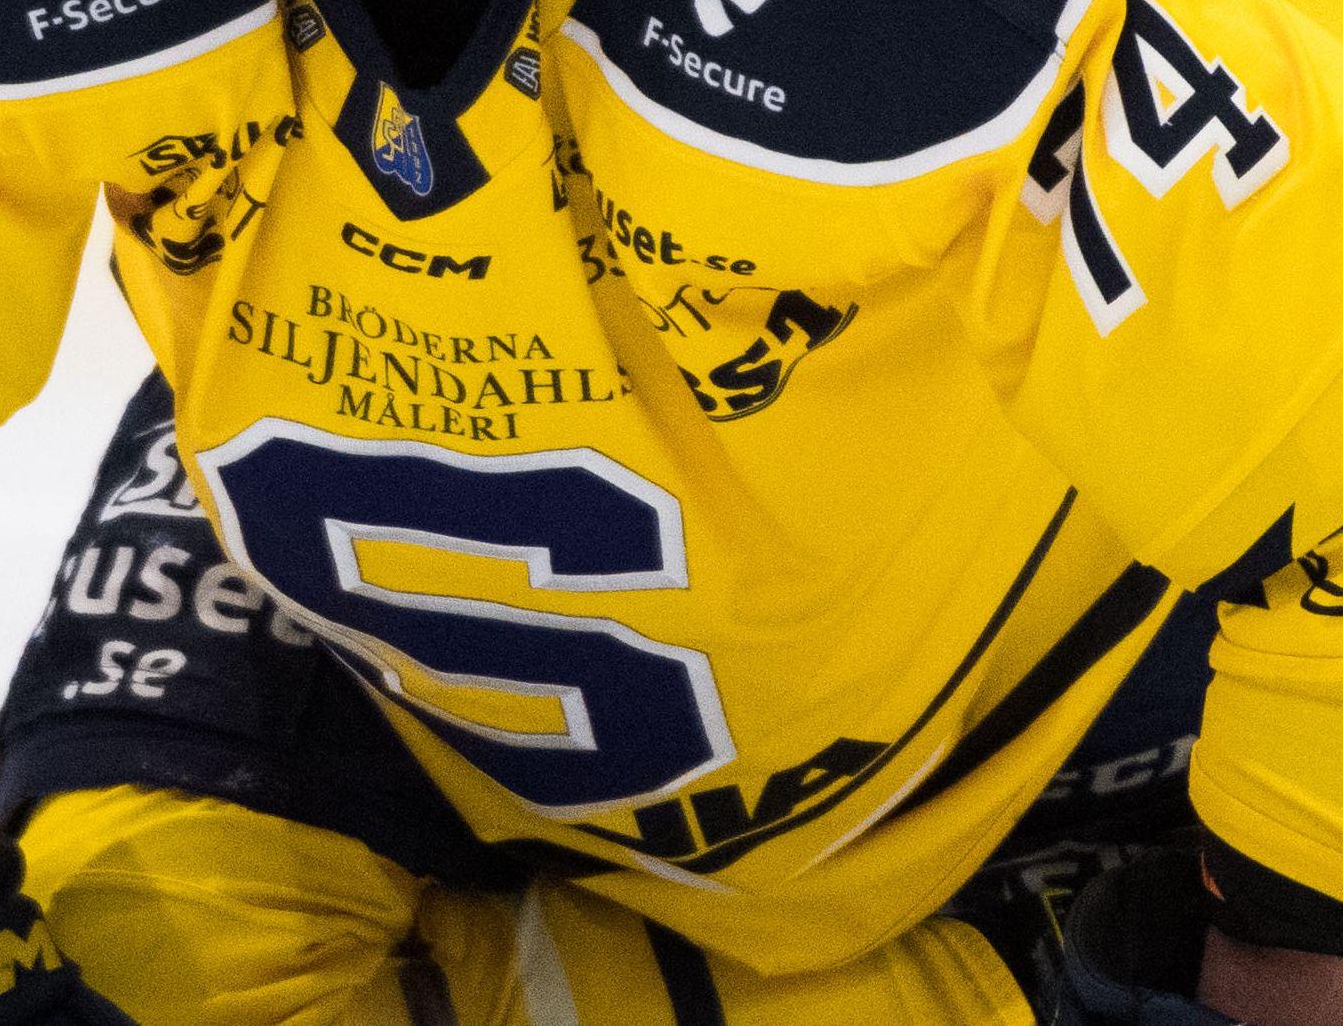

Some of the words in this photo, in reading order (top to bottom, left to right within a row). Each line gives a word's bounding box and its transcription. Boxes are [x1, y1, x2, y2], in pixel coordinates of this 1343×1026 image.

[642, 14, 787, 114] F-Secure
[341, 221, 493, 281] CCM
[306, 284, 555, 365] BRÖDERNA
[336, 384, 521, 441] MÅLERI
